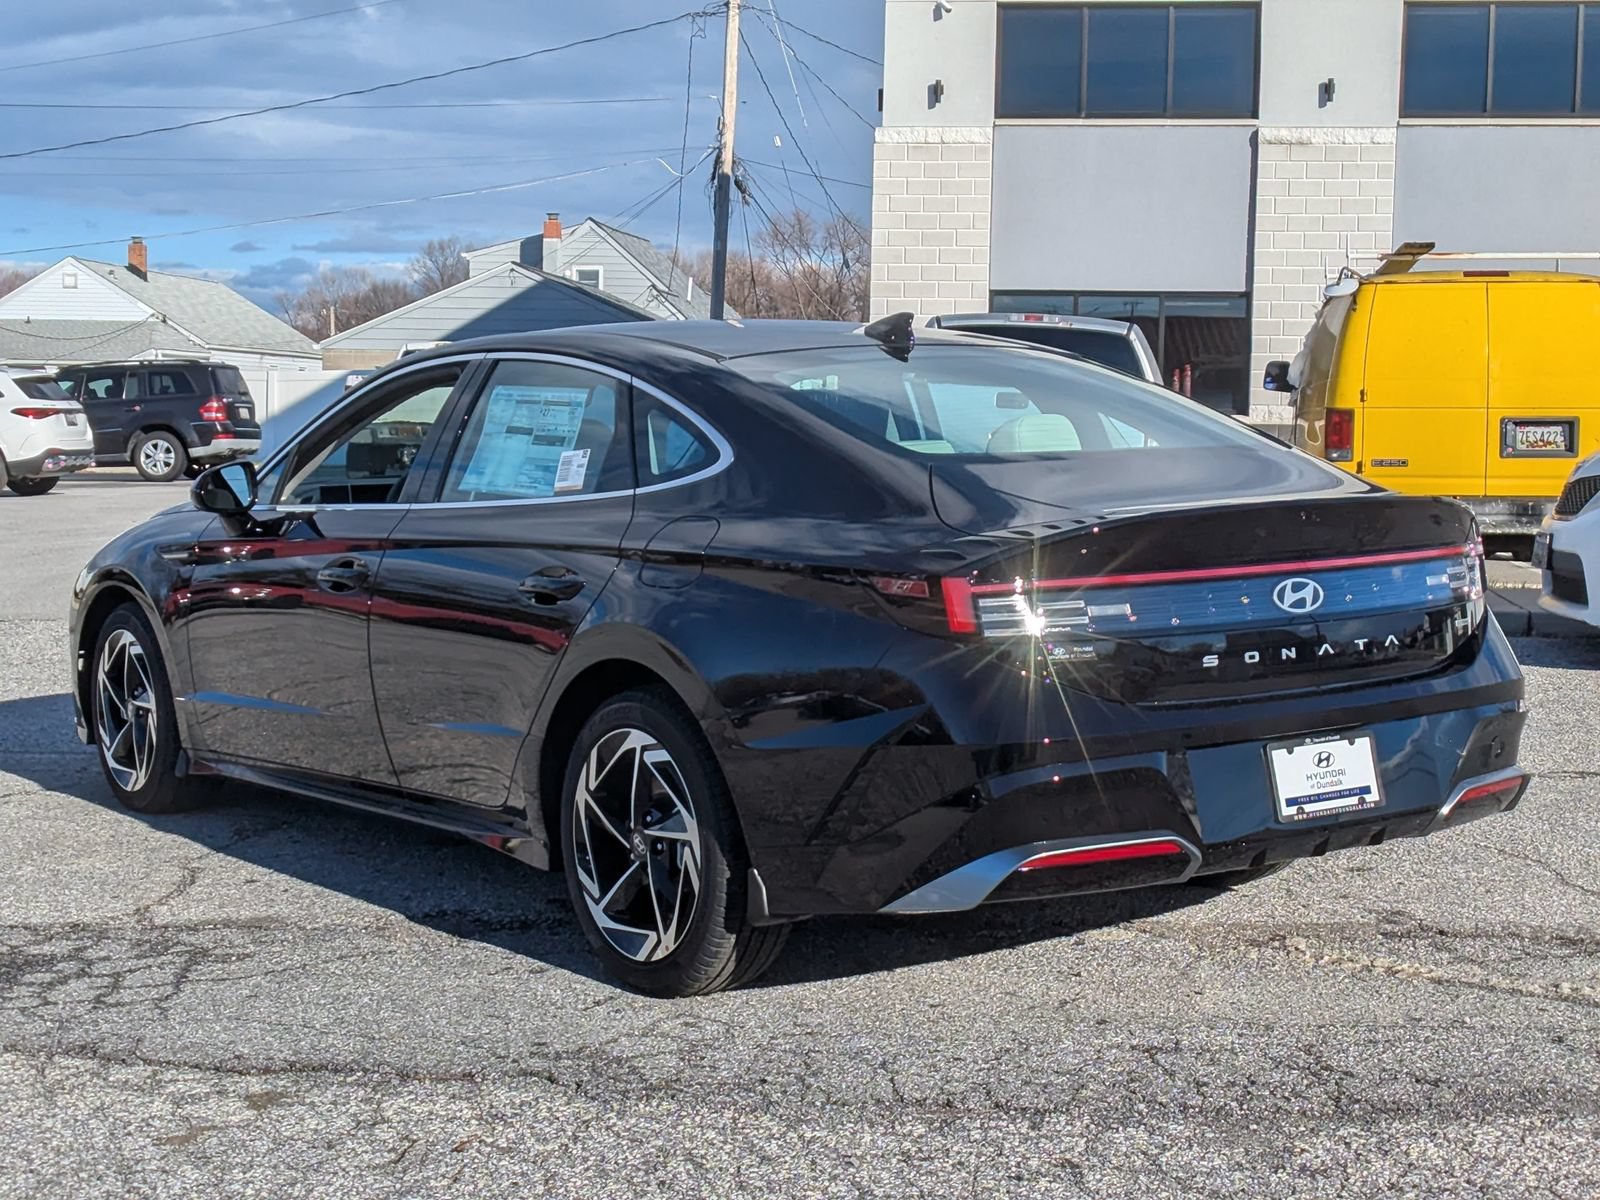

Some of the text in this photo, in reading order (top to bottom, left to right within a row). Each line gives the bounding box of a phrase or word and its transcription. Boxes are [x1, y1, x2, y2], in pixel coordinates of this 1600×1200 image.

[1202, 634, 1399, 667] SONATA
[1306, 768, 1346, 781] HYUNDAI
[1316, 779, 1343, 789] Dundalk
